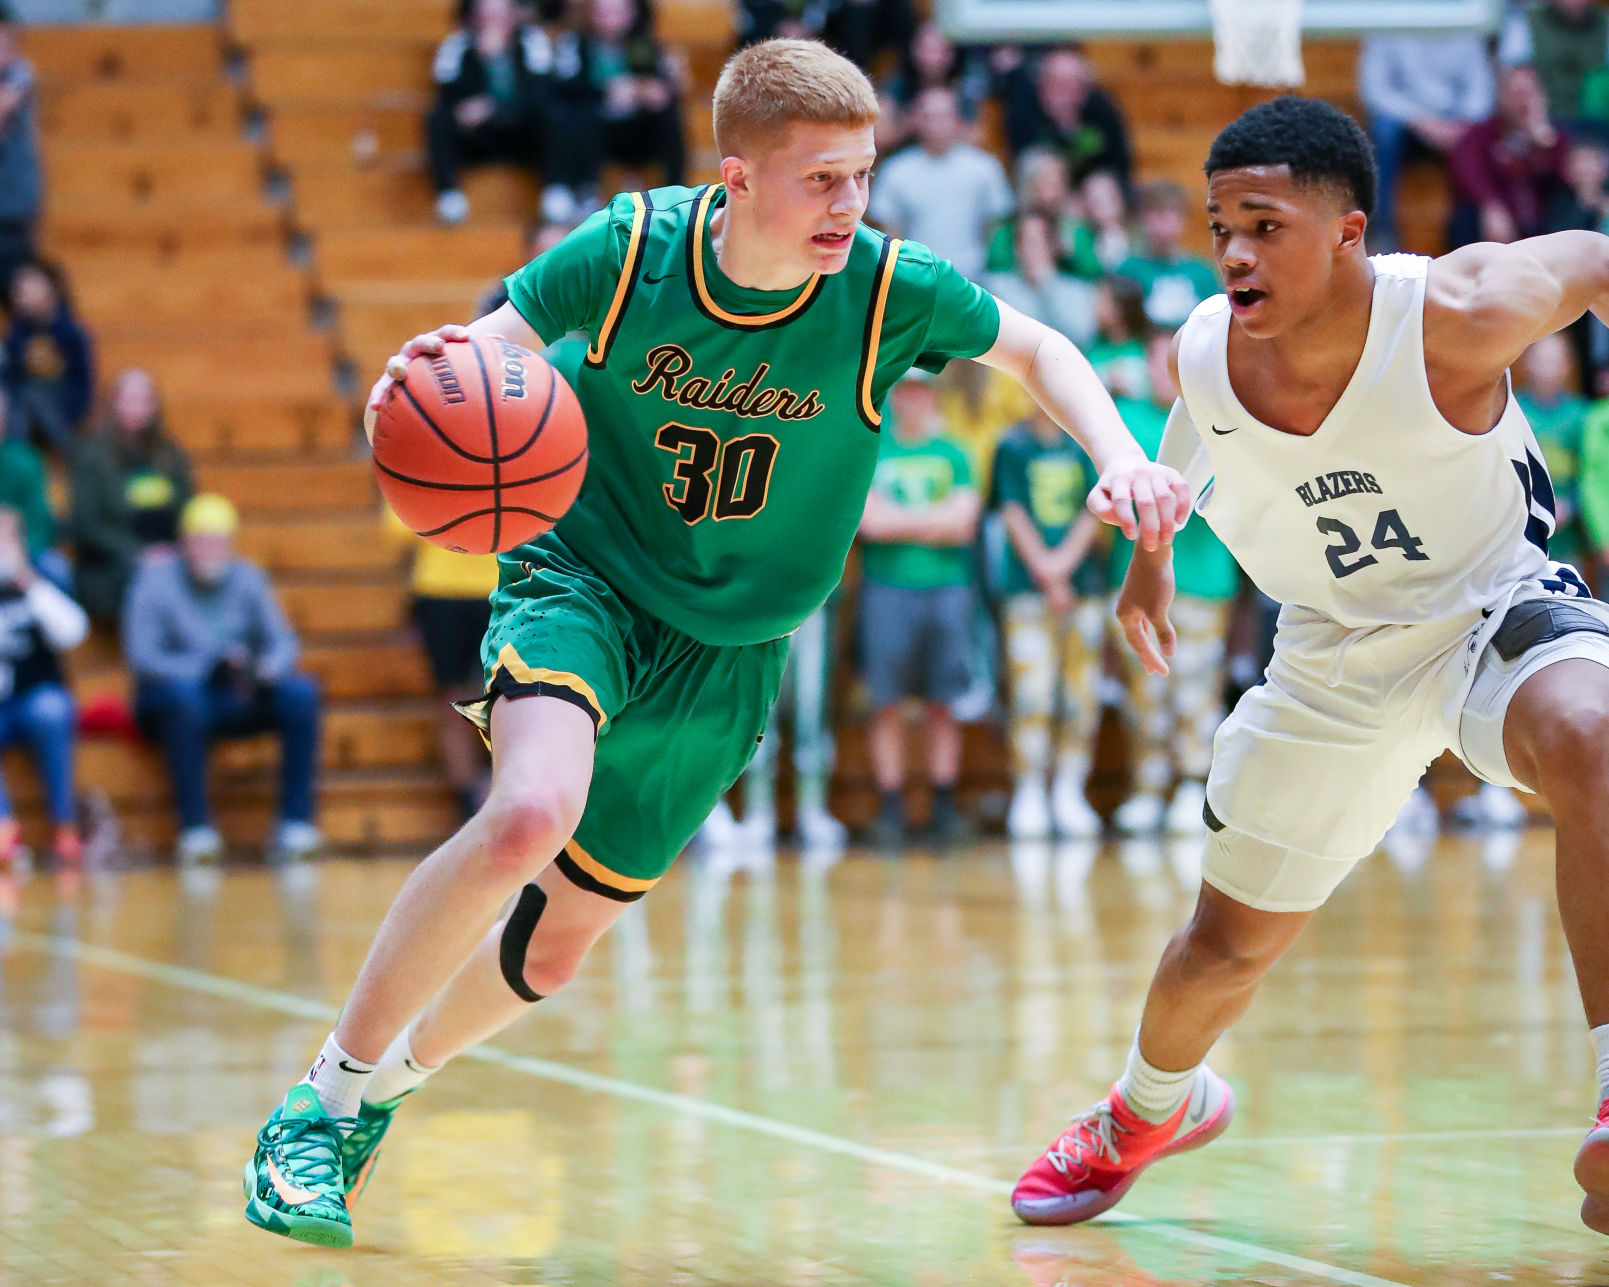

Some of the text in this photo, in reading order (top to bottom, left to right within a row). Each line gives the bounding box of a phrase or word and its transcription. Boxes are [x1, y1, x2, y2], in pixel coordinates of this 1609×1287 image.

[631, 343, 825, 421] Raiders
[654, 420, 781, 526] 30
[1295, 470, 1384, 508] BLAZERS
[1316, 508, 1431, 579] 24
